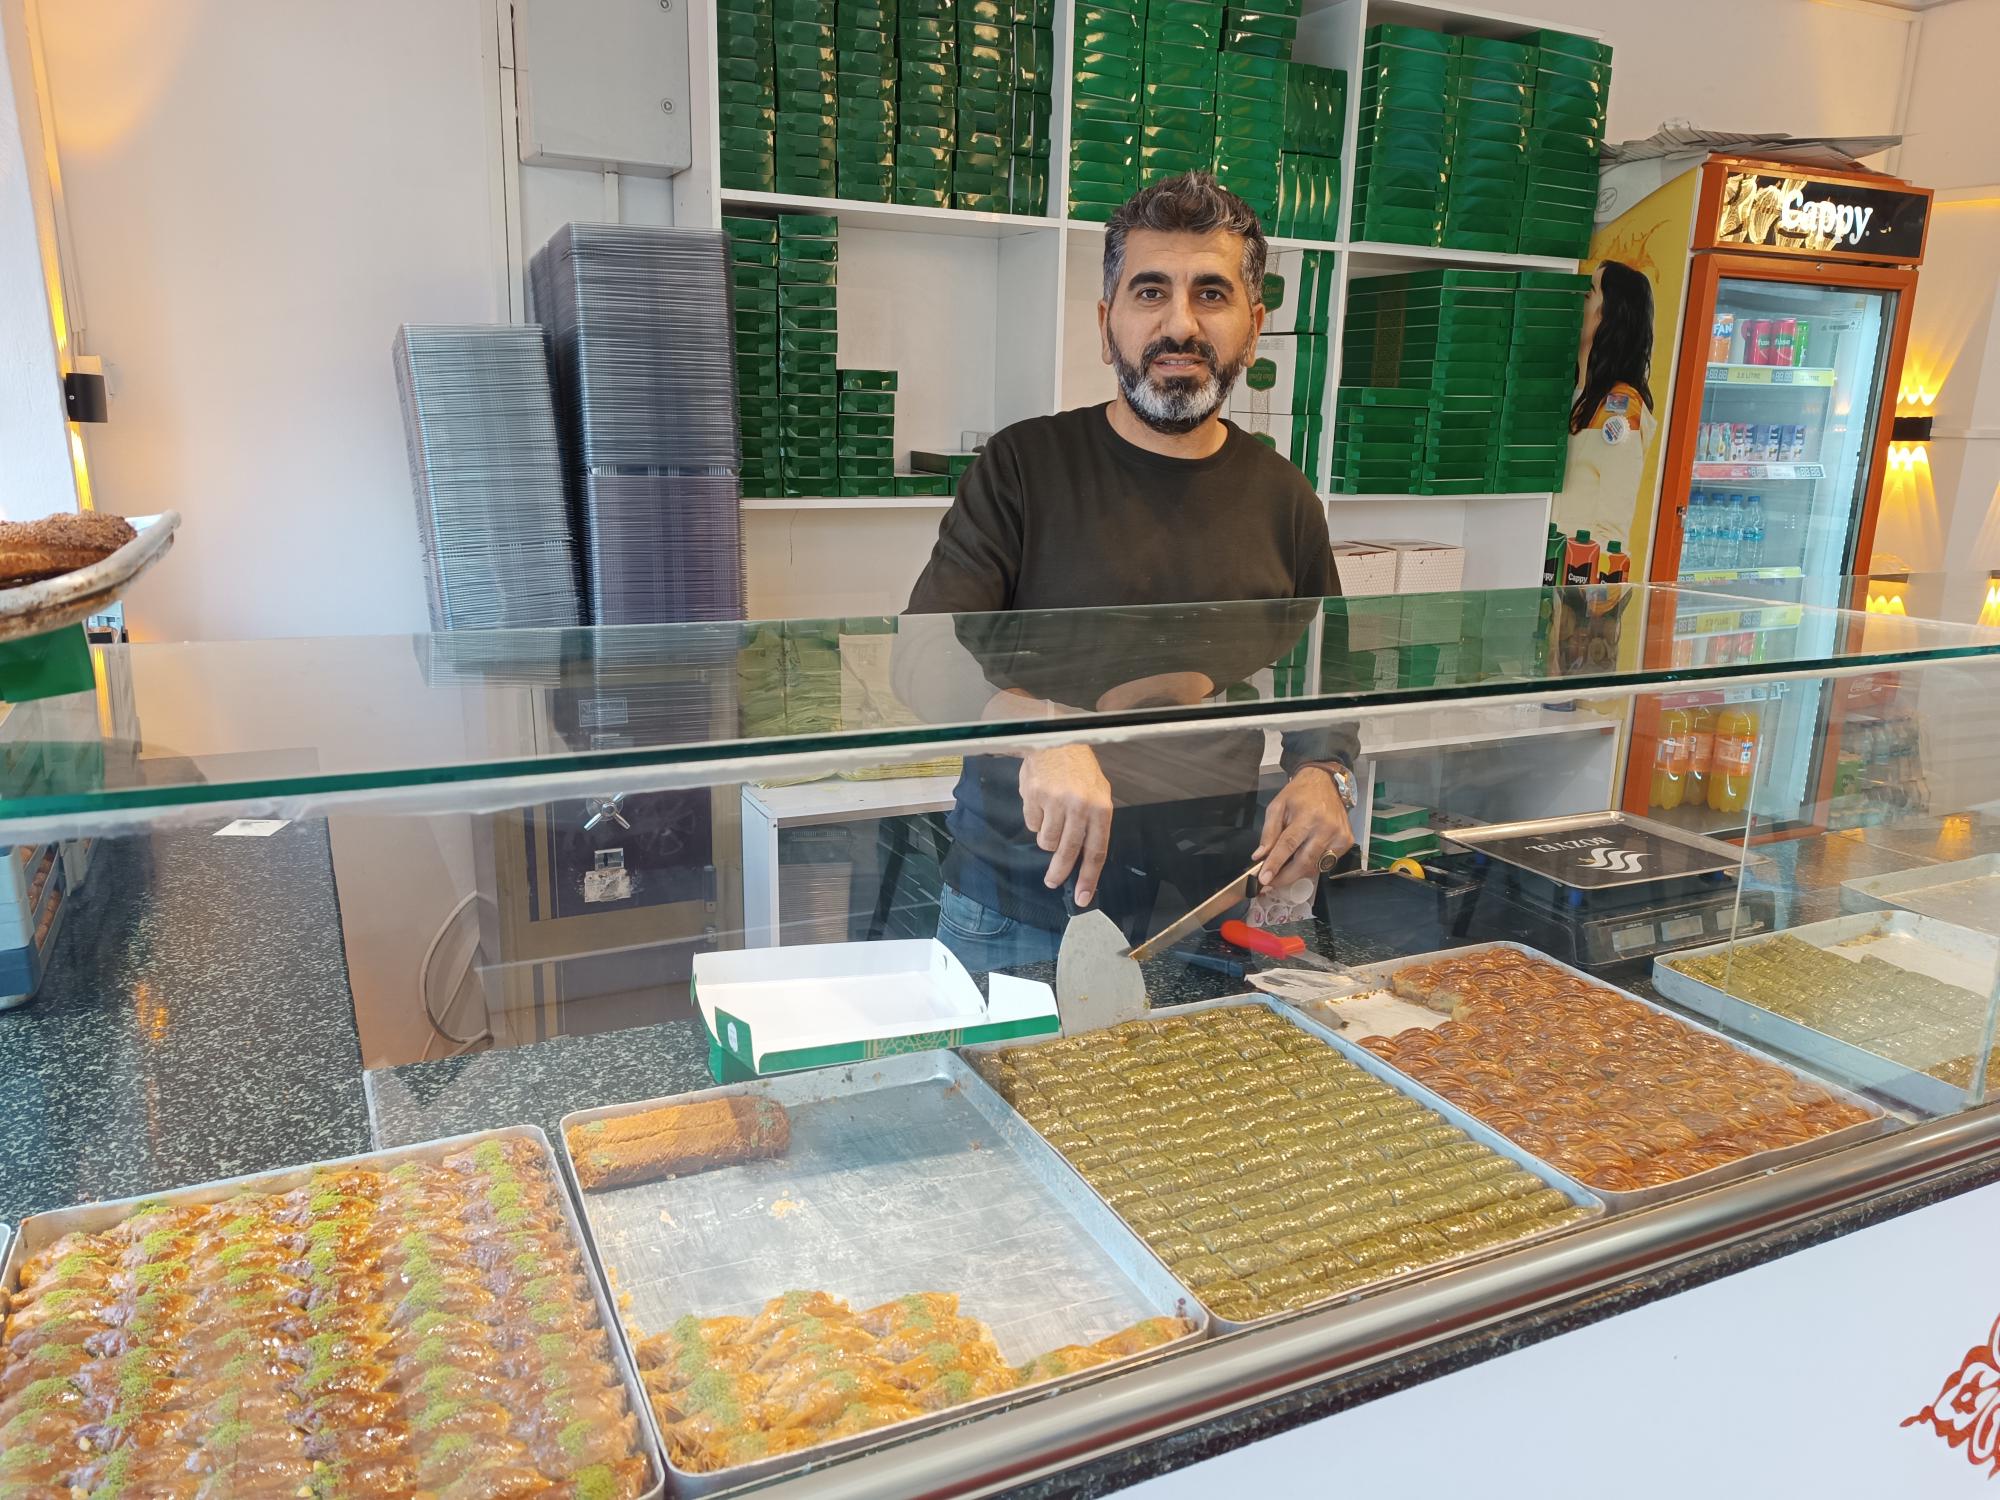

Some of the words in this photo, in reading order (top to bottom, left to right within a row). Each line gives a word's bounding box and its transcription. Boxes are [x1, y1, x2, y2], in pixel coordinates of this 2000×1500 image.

[1780, 189, 1873, 245] Cappy
[1567, 573, 1589, 584] Cappy
[1524, 836, 1615, 853] BOZYEL
